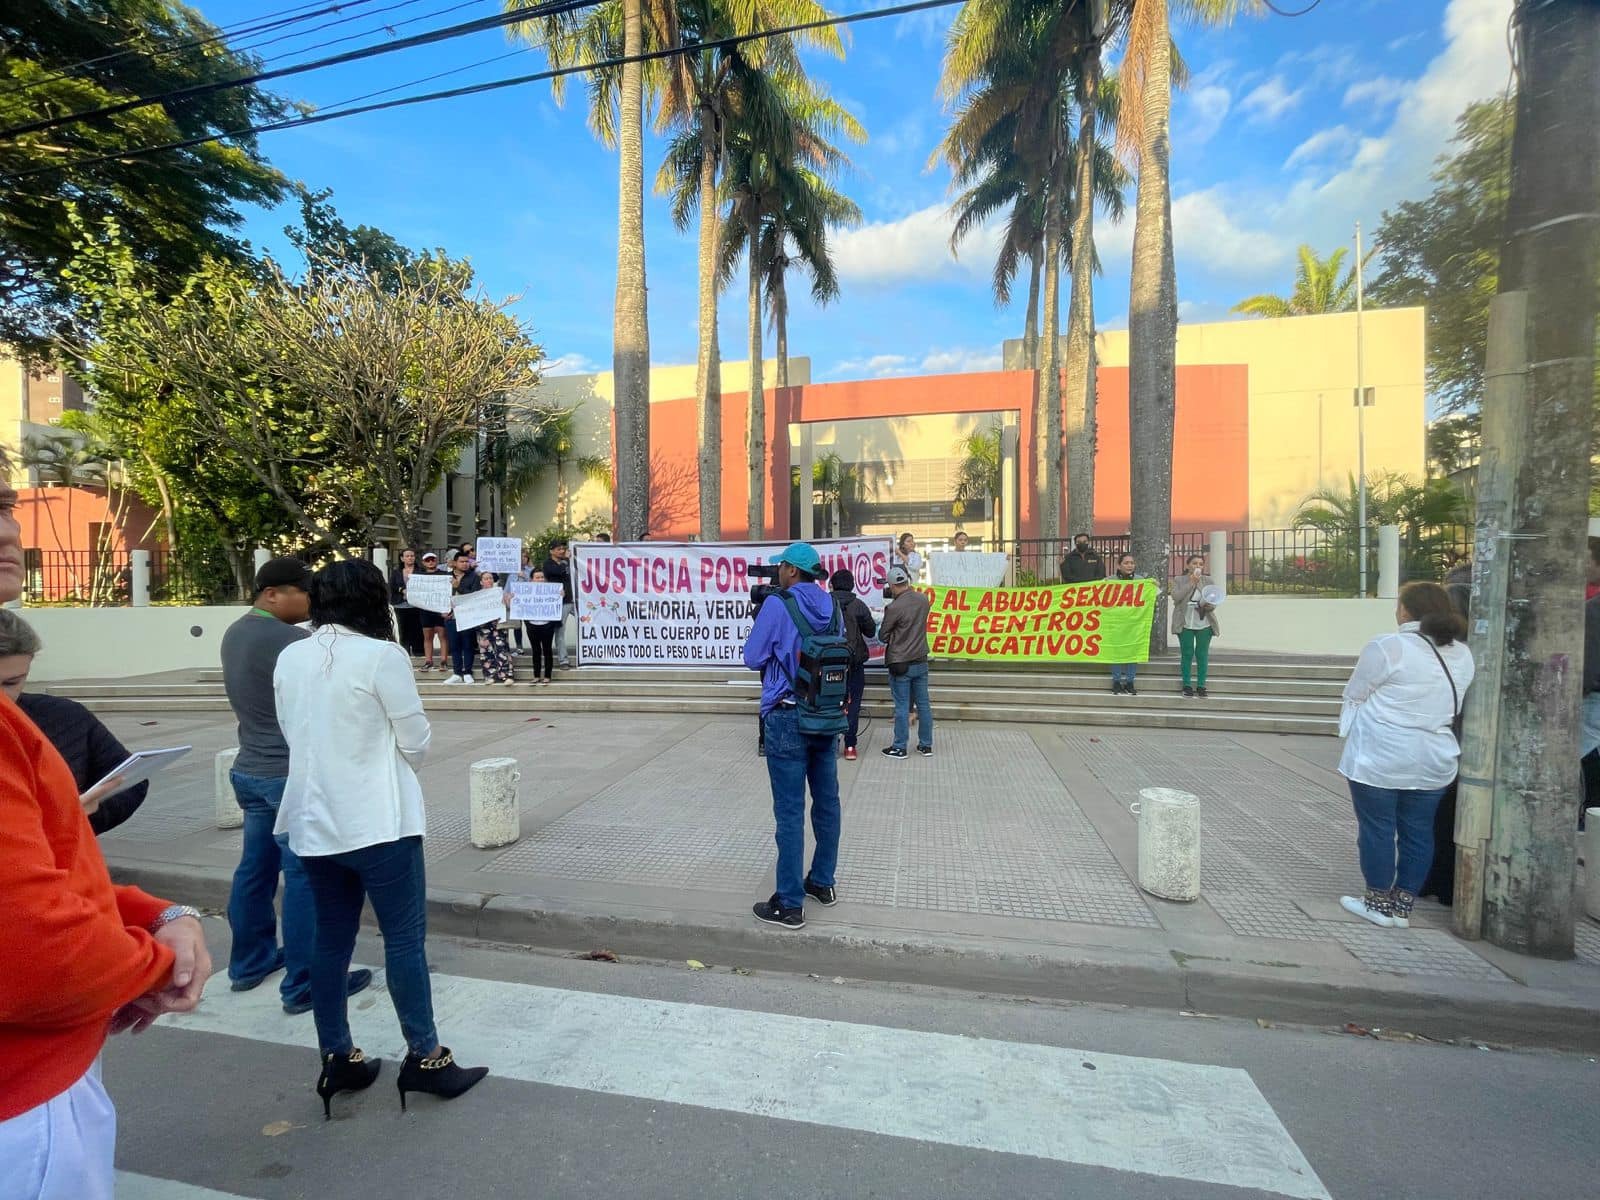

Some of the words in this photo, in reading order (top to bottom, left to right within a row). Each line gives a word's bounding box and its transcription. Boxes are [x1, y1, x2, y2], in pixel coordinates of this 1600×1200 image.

[581, 557, 692, 594] JUSTICIA
[700, 556, 750, 593] POR
[942, 589, 970, 611] AL
[978, 590, 1052, 613] ABUSO
[1060, 583, 1145, 609] SEXUAL
[705, 600, 753, 619] VERDA
[581, 625, 597, 640] LA
[601, 625, 630, 640] VIDA
[632, 625, 641, 640] Y
[643, 625, 657, 640] EL
[660, 625, 710, 640] CUERPO
[714, 625, 729, 640] DE
[737, 625, 752, 640] L@
[926, 611, 961, 634] EN
[973, 610, 1102, 634] CENTROS
[581, 644, 626, 658] EXIGIMOS
[628, 644, 652, 658] TODO
[654, 645, 665, 658] EL
[666, 645, 689, 658] PESO
[691, 645, 702, 659] DE
[705, 646, 716, 659] LA
[719, 646, 736, 660] LEY
[932, 634, 1103, 656] EDUCATIVOS
